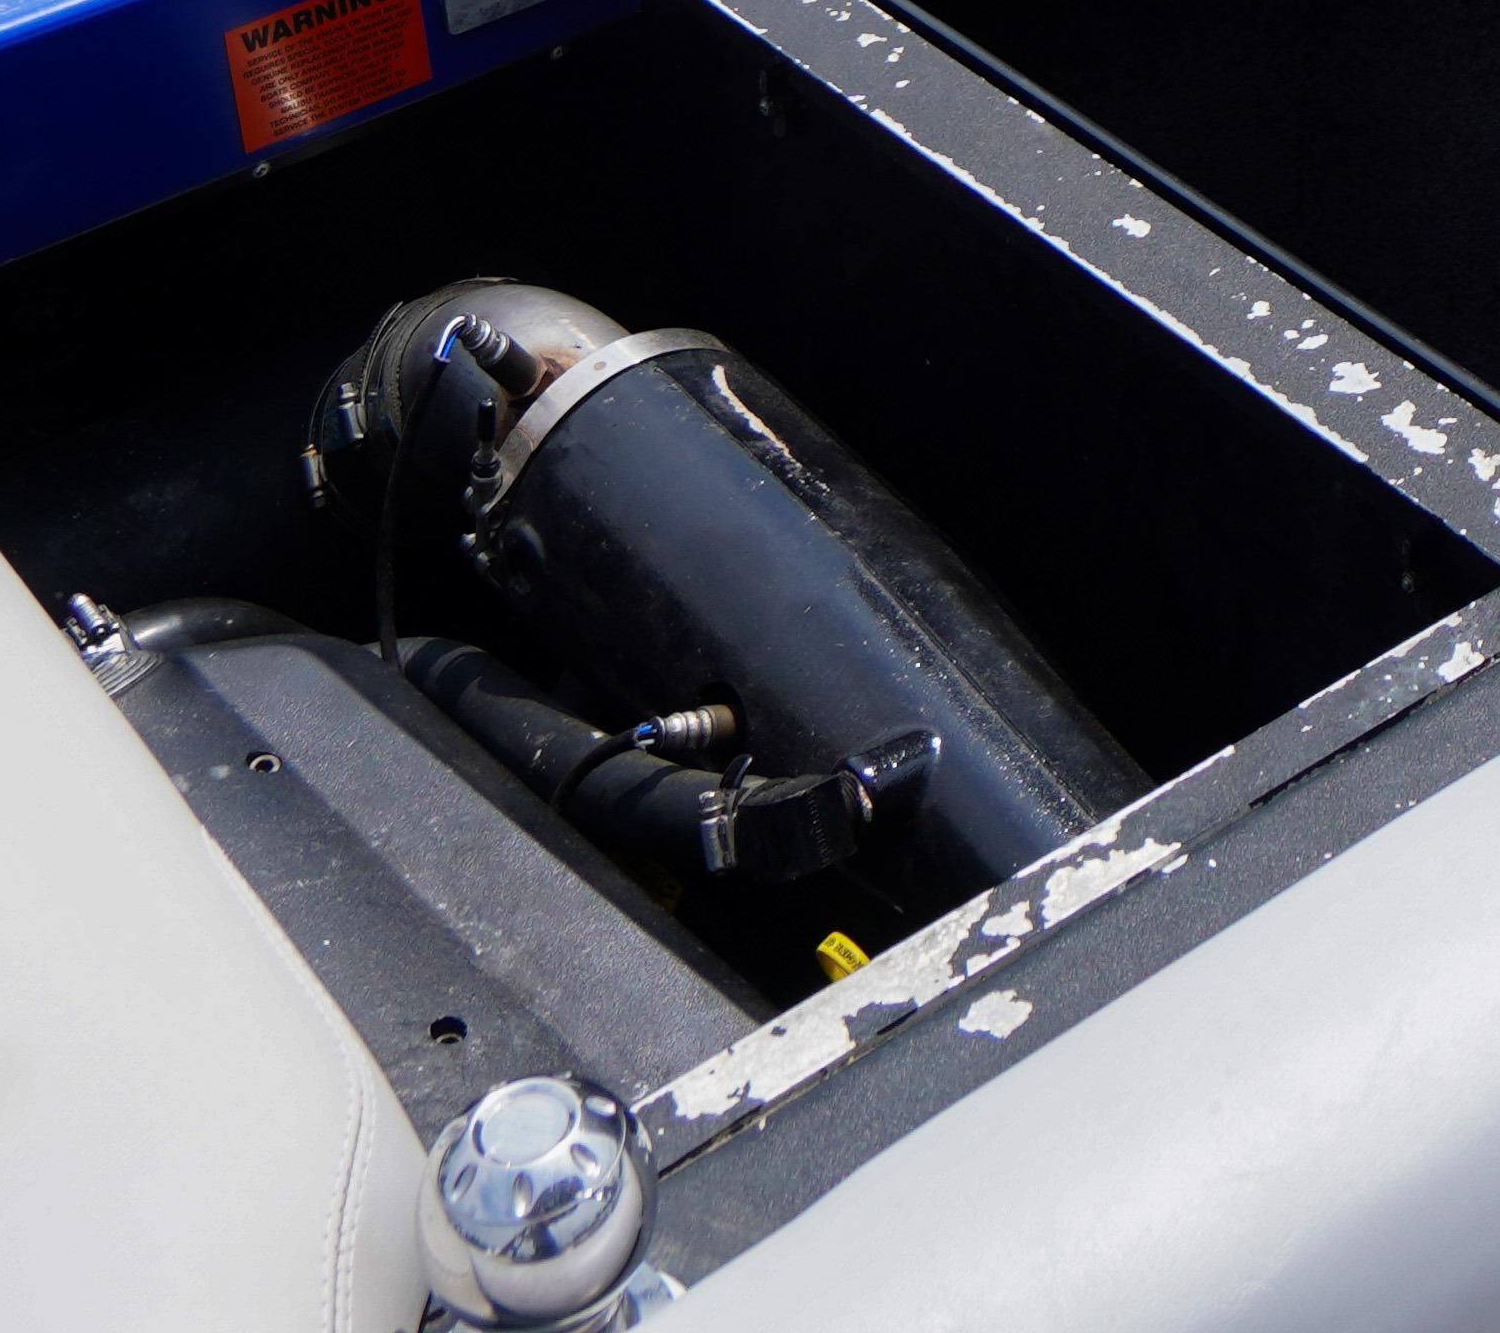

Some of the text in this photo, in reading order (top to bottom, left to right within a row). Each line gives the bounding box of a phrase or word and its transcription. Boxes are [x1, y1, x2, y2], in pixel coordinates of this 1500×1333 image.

[242, 57, 285, 79] REQUIRES
[287, 43, 320, 62] SPECIAL
[246, 47, 282, 68] SERVICE
[259, 80, 276, 93] ARE
[277, 71, 299, 85] ONLY
[301, 53, 344, 76] AVAILABLE
[260, 85, 288, 102] BOATS
[268, 89, 303, 109] SHOULD
[273, 117, 308, 137] SERVICE
